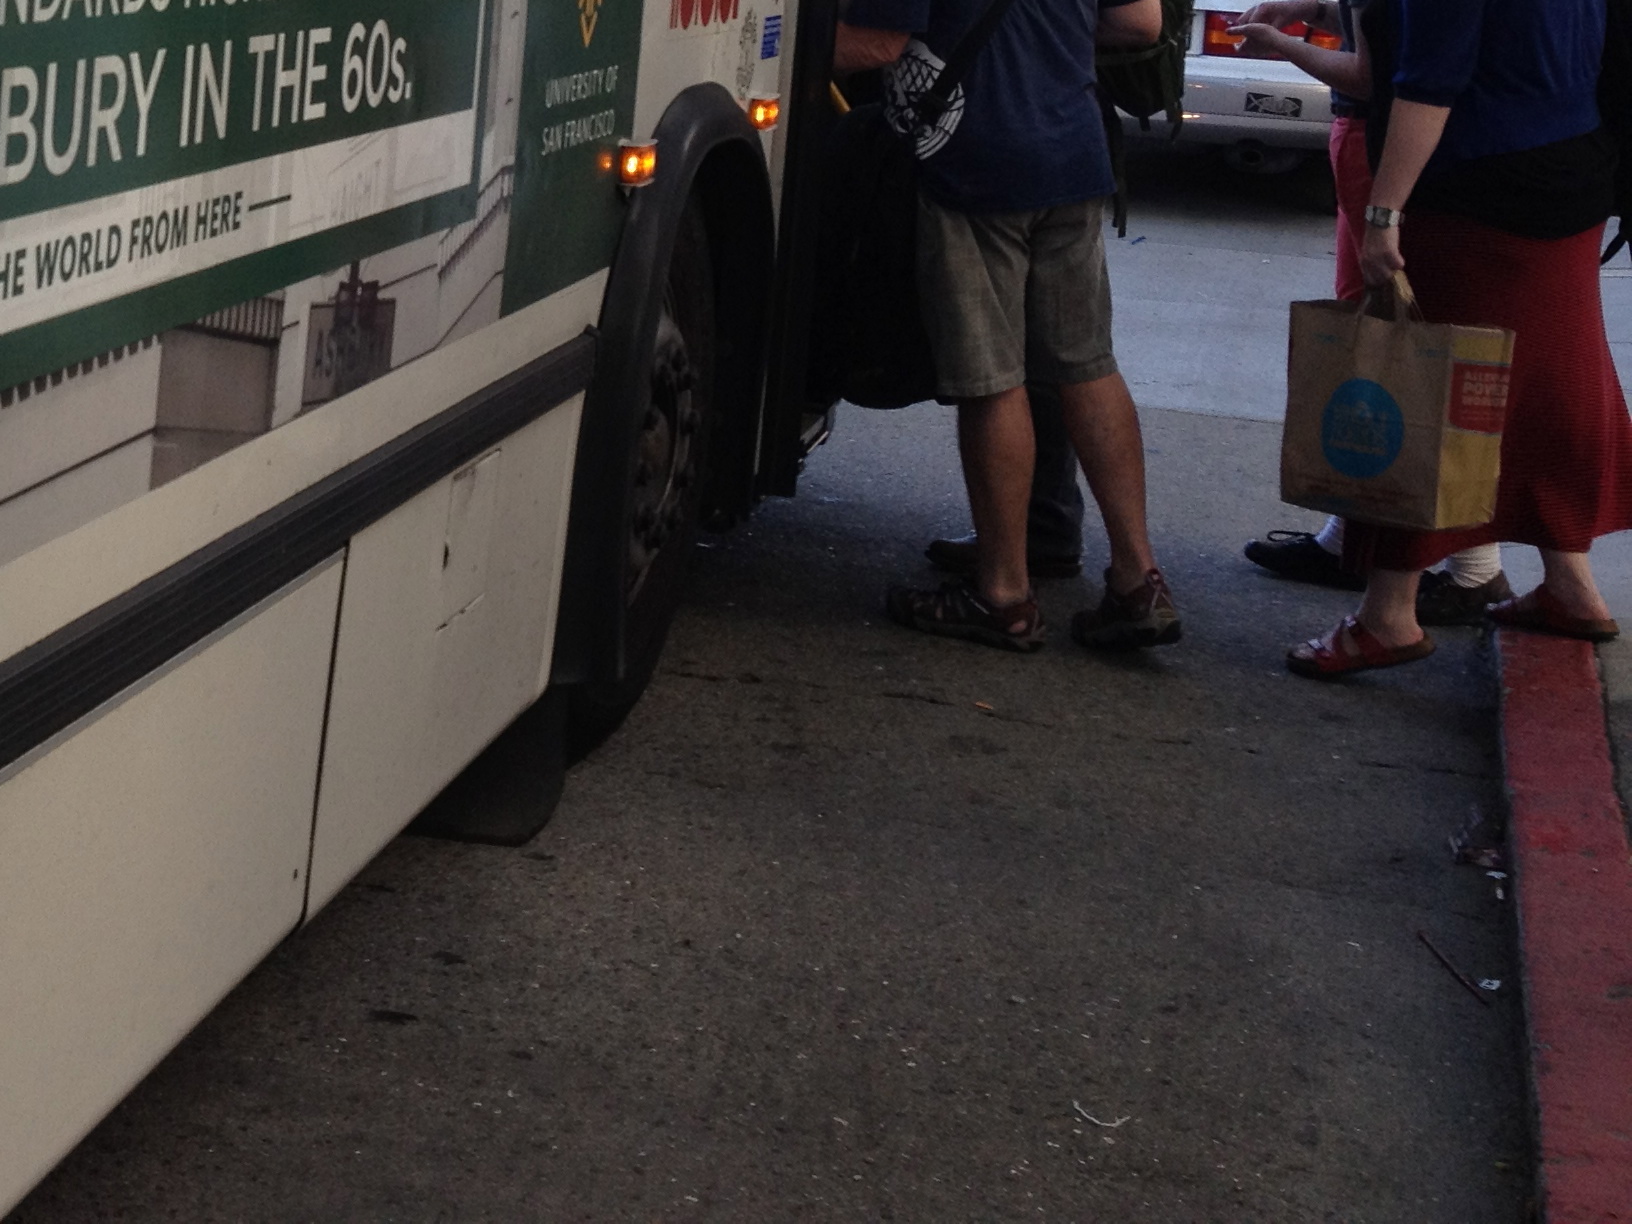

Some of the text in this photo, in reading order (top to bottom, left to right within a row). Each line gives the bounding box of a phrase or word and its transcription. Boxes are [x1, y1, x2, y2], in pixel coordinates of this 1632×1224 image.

[179, 40, 232, 148] IN
[248, 26, 333, 131] THE
[545, 65, 619, 109] UNIVERSITY OF
[541, 108, 615, 156] SAN FRANCISCO
[35, 229, 121, 290] WORLD
[128, 211, 189, 261] FROM
[194, 191, 243, 243] HERE
